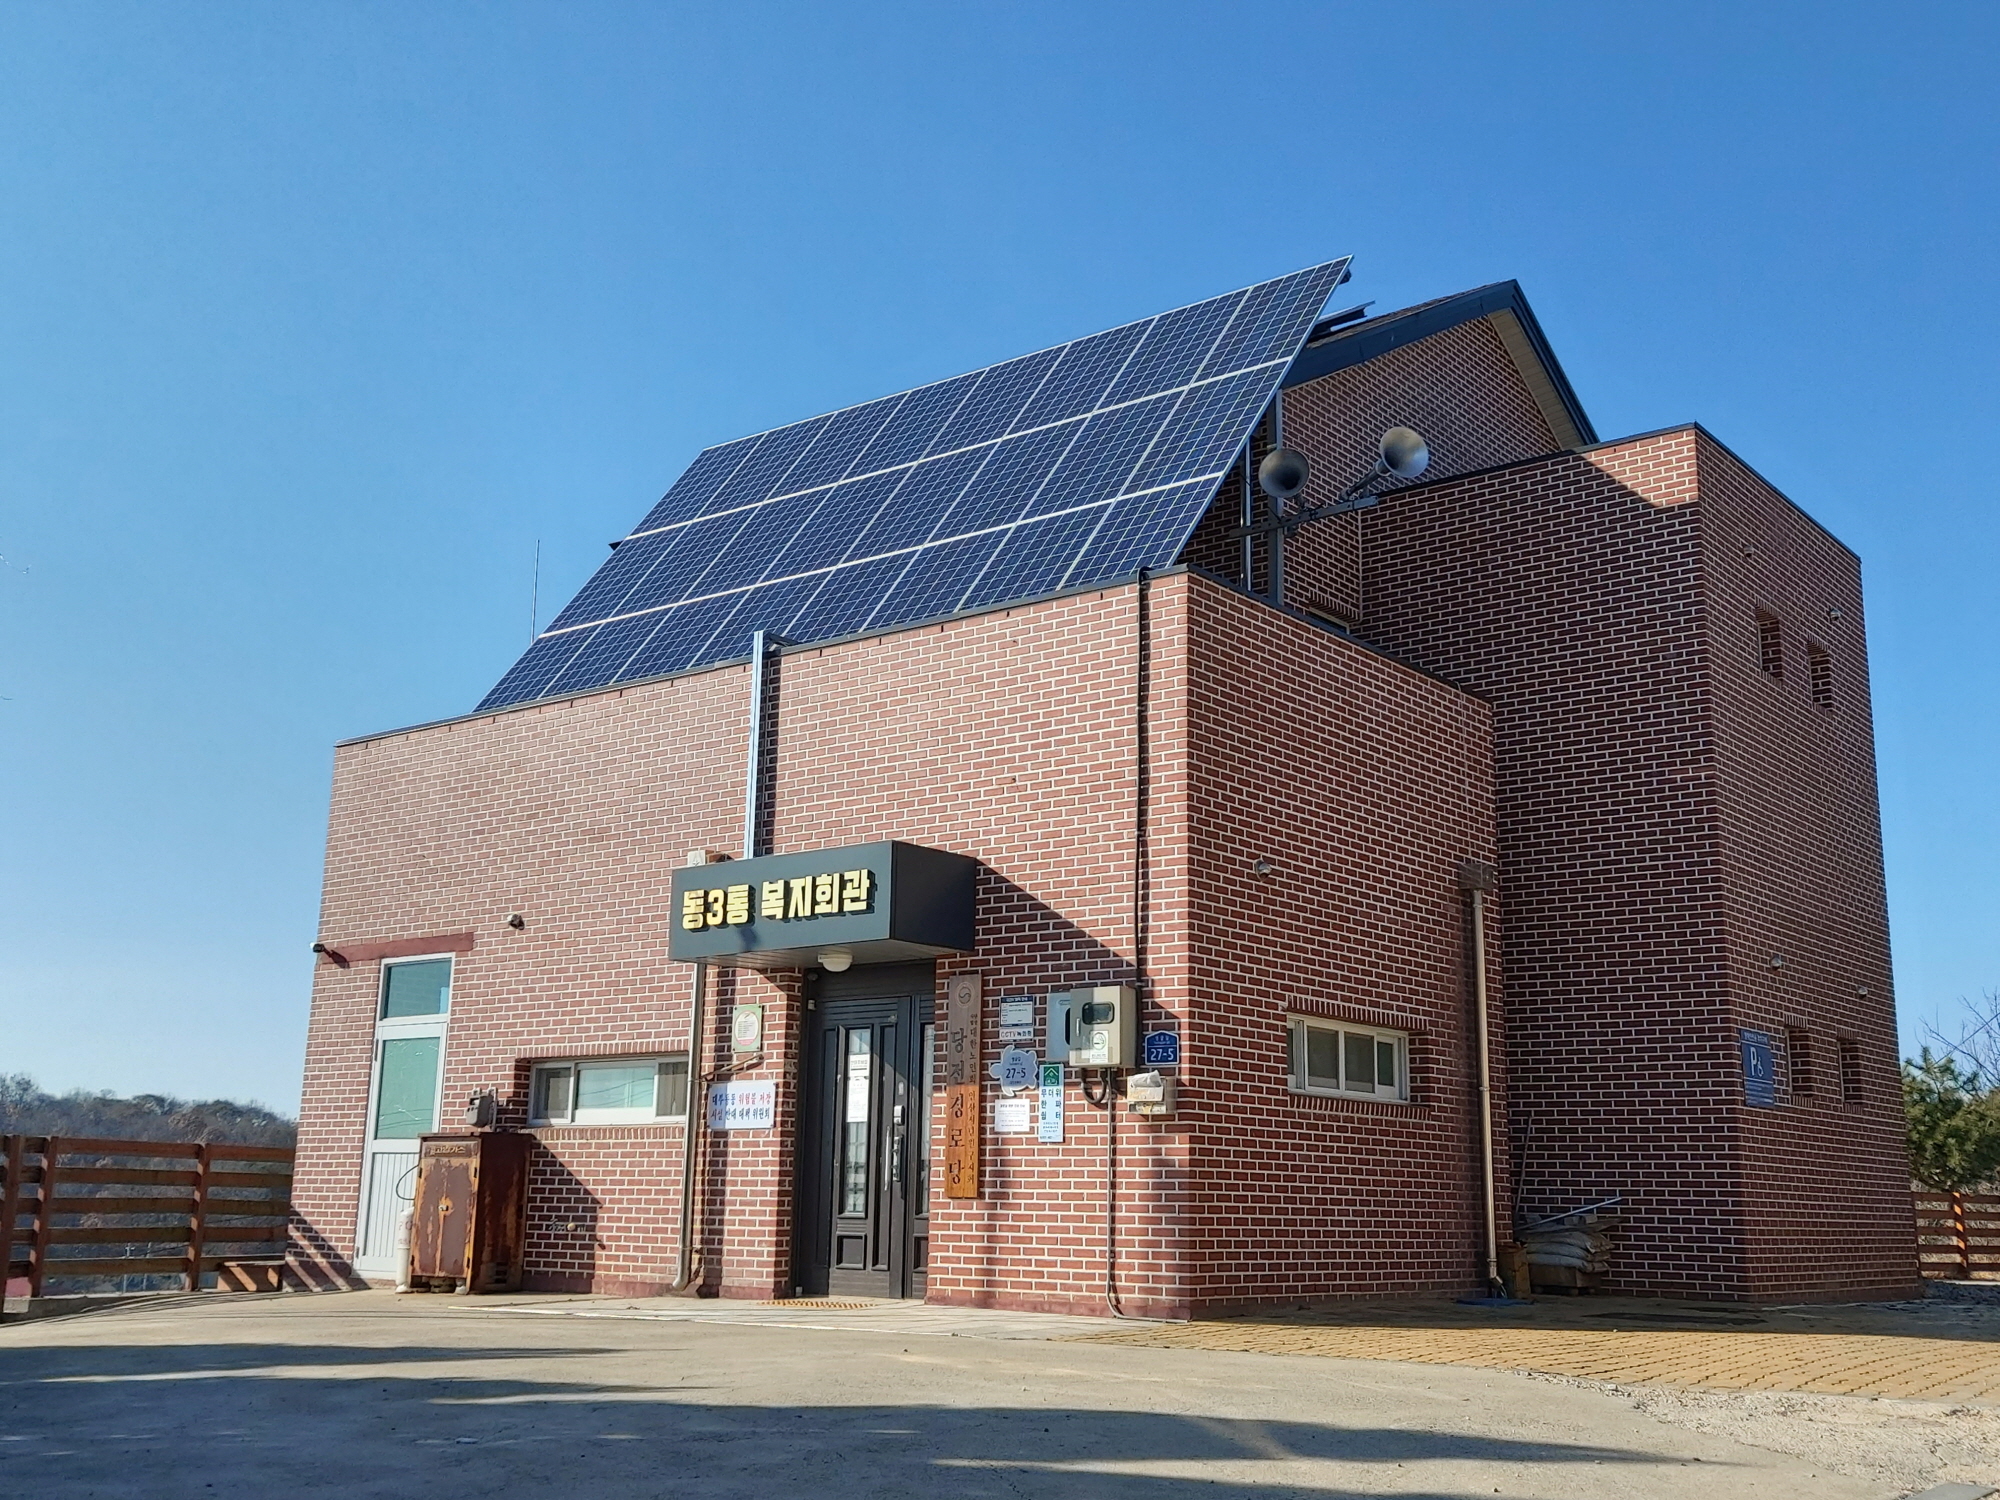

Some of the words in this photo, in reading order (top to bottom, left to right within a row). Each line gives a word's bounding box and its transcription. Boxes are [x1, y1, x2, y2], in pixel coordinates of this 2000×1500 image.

[682, 883, 752, 930] 동3통
[761, 868, 871, 920] 복지회관
[1150, 1048, 1174, 1061] 27-5
[1750, 1046, 1757, 1076] P
[1005, 1067, 1026, 1079] 27-5
